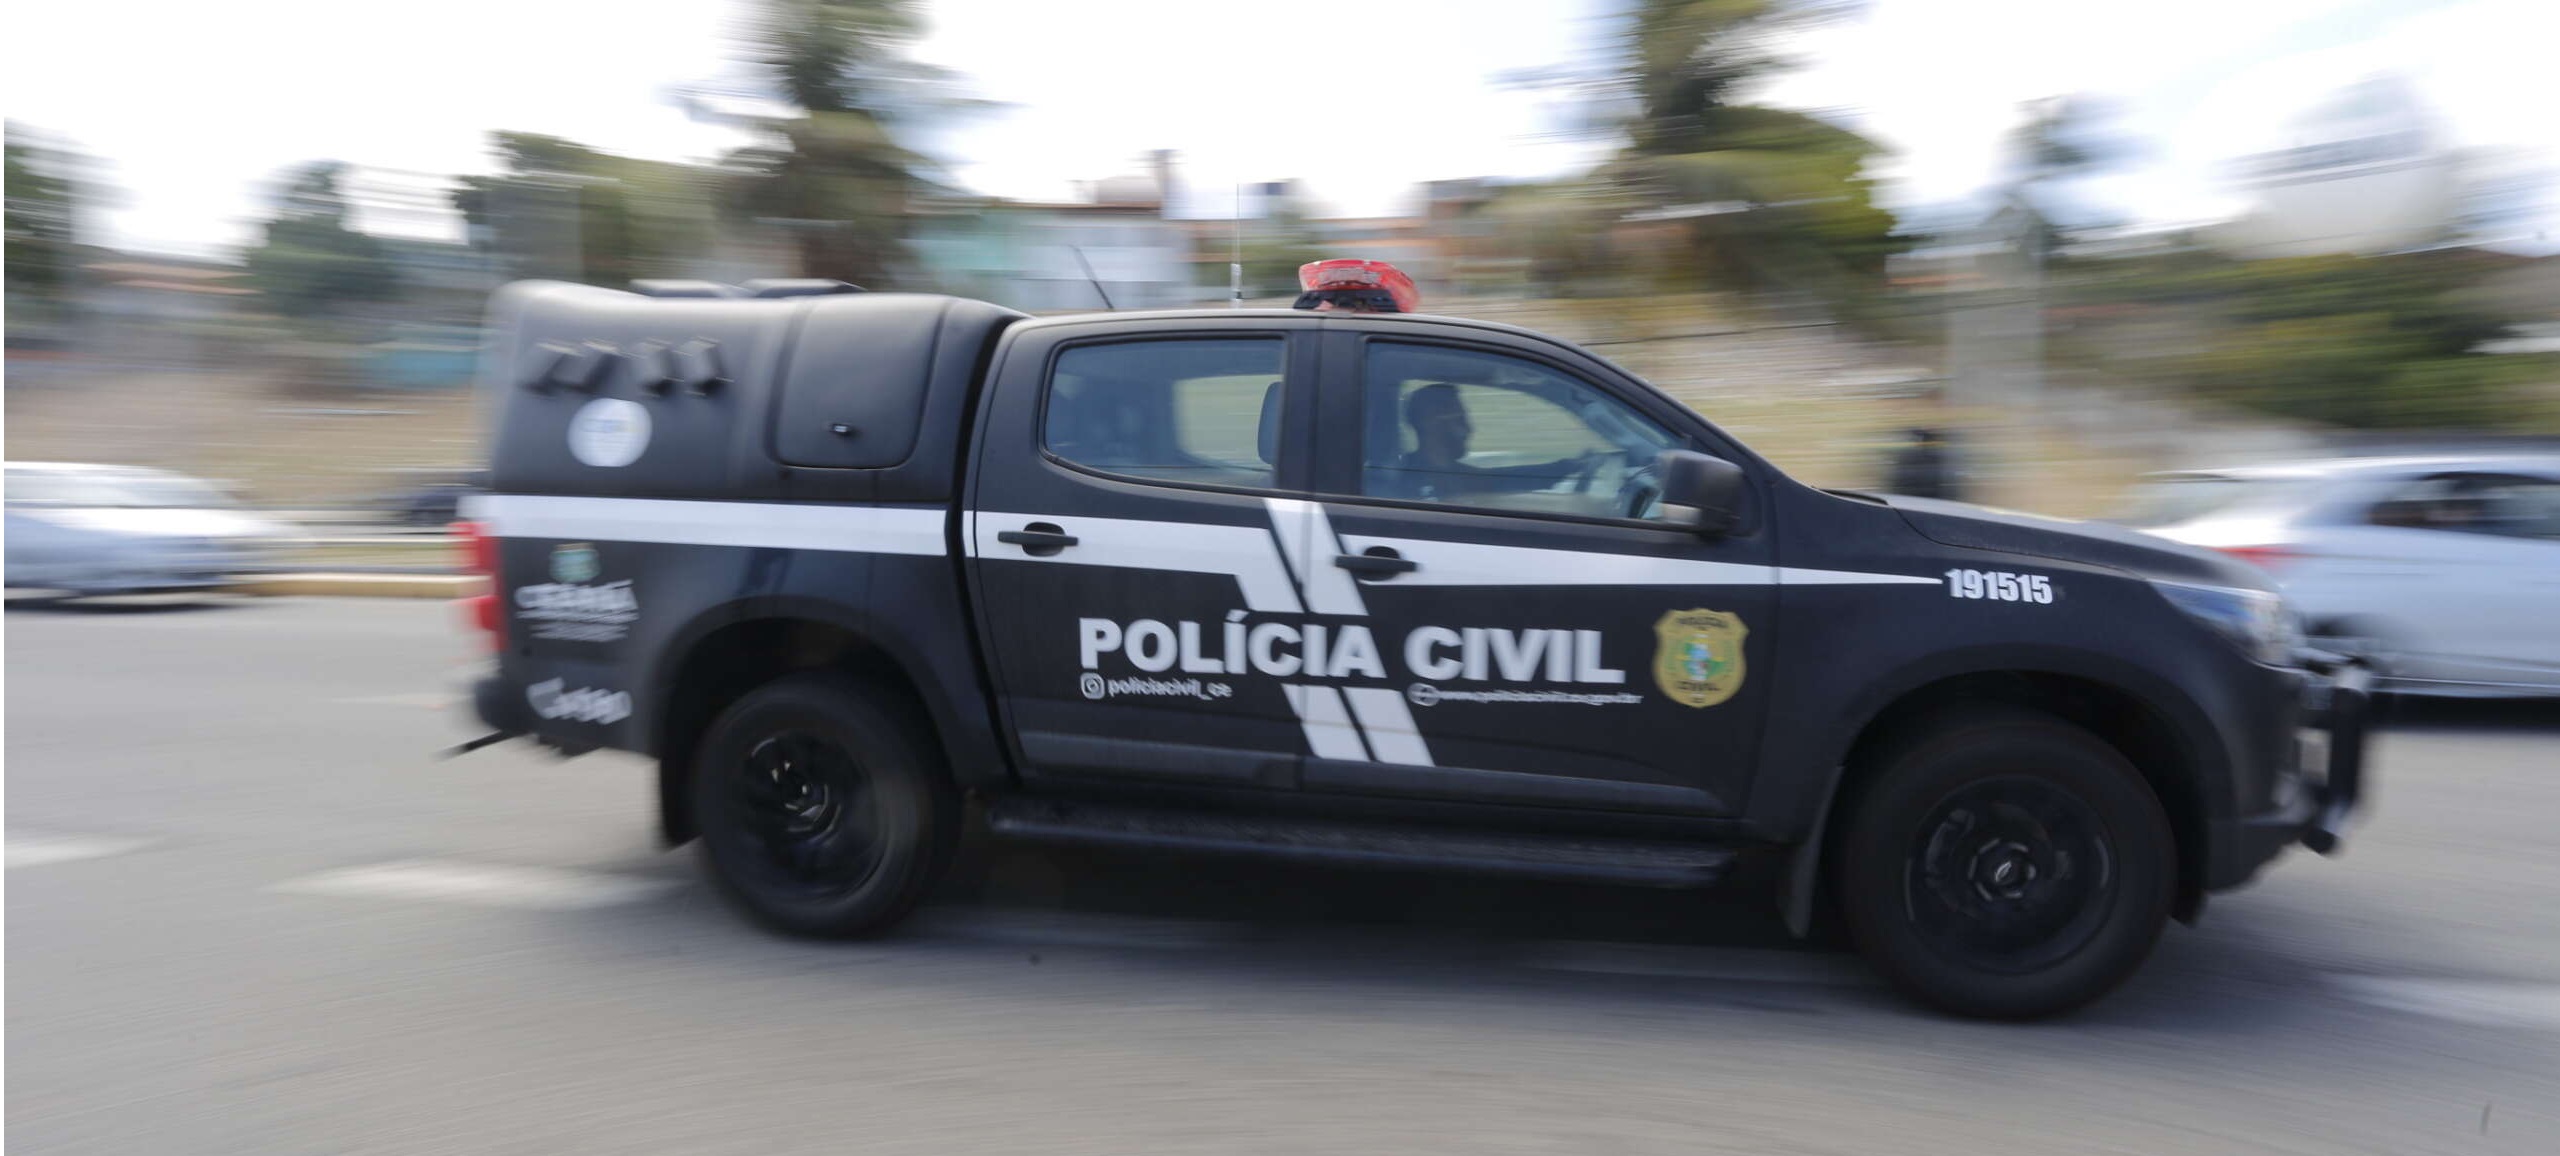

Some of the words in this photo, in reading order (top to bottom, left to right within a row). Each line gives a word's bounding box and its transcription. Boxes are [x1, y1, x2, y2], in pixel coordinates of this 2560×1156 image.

[1944, 568, 2053, 604] 191515
[1079, 609, 1388, 678] POLÍCIA
[1403, 625, 1626, 684] CIVIL
